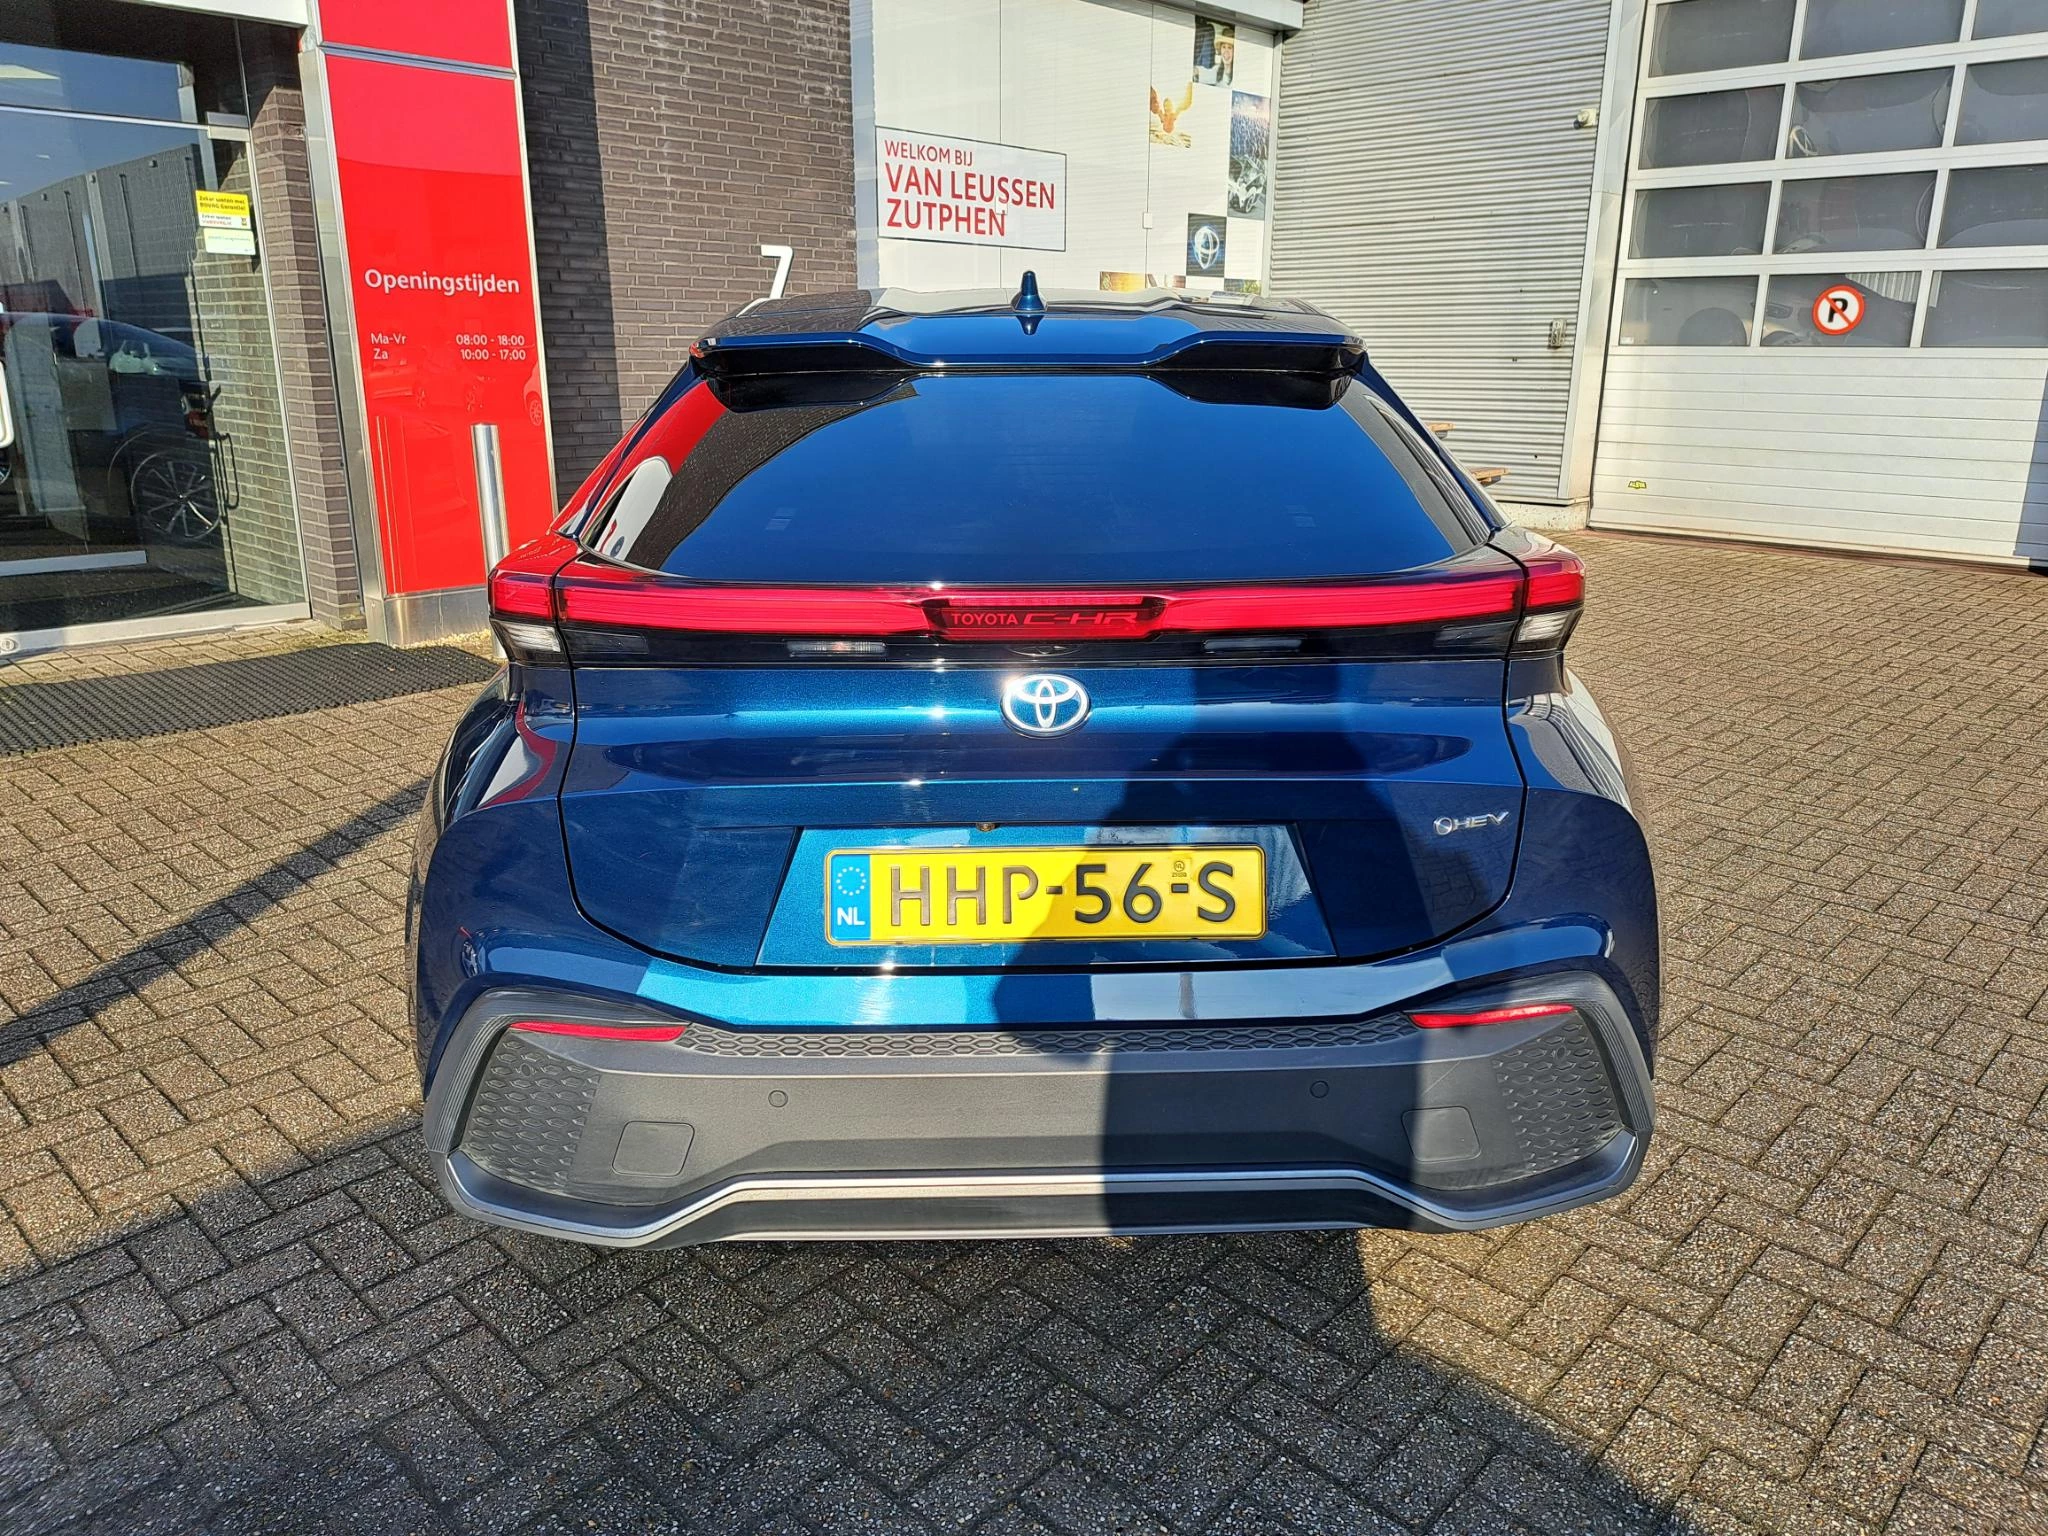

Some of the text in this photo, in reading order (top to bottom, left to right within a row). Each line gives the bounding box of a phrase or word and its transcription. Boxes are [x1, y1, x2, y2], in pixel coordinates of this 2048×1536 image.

[884, 139, 973, 167] WELKOM BIJ
[884, 162, 1055, 210] VAN LEUSSEN
[886, 197, 1006, 237] ZUTPHEN
[364, 268, 521, 297] Openingstijden
[760, 244, 794, 300] 7
[370, 332, 407, 345] Ma-Vr
[455, 334, 488, 346] 08:00
[497, 334, 525, 346] 18:00
[373, 348, 389, 360] Za
[460, 348, 489, 360] 10:00
[499, 349, 526, 361] 17:00
[951, 612, 1138, 626] TOYOTA C-HR
[836, 860, 1236, 927] NL HHP-56-S
